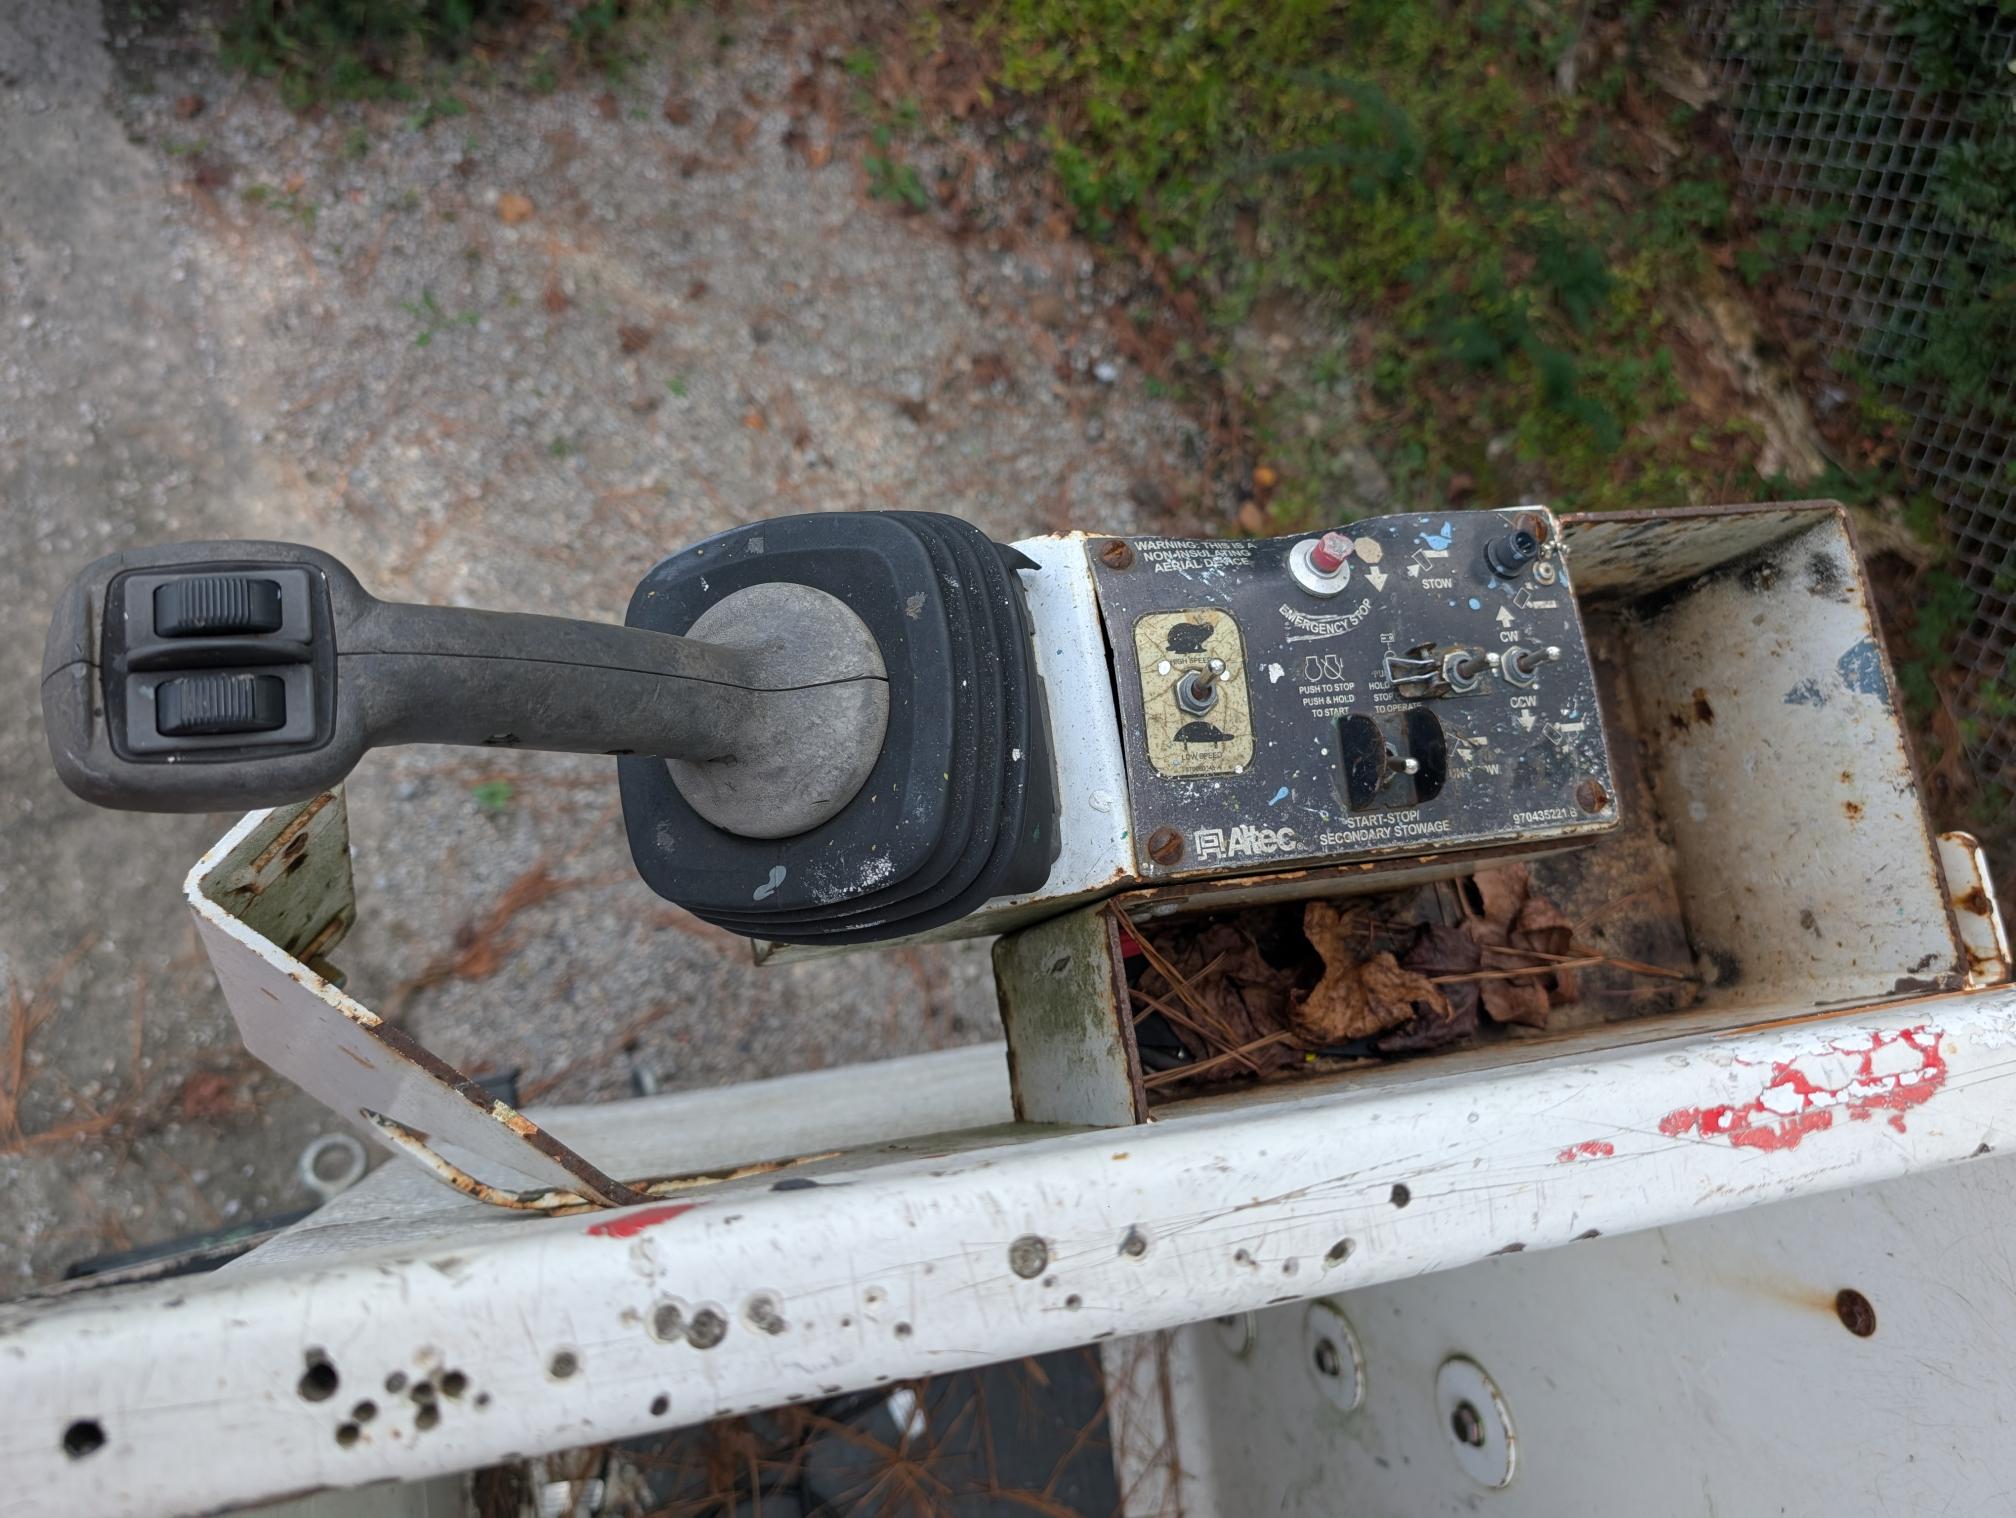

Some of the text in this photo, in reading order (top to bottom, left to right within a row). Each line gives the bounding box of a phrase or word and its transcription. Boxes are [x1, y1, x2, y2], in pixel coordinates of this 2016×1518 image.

[1134, 541, 1200, 551] WARNING:
[1202, 541, 1230, 550] THIS
[1143, 549, 1252, 562] NON-INSULATING
[1154, 557, 1250, 573] AERIAL DEVICE
[1421, 578, 1453, 590] STOW
[1278, 598, 1372, 634] EMERGENCY STOP
[1499, 630, 1519, 642] CW
[1189, 656, 1214, 664] SPEE
[1299, 682, 1355, 694] PUSH TO STOP
[1368, 681, 1391, 690] HOLD
[1302, 694, 1355, 706] PUSH & HOLD
[1509, 696, 1537, 708] CCW
[1312, 706, 1350, 717] TO START
[1374, 705, 1386, 713] TO
[1319, 819, 1452, 846] SECONDARY STOWAGE
[1228, 824, 1297, 858] Altec
